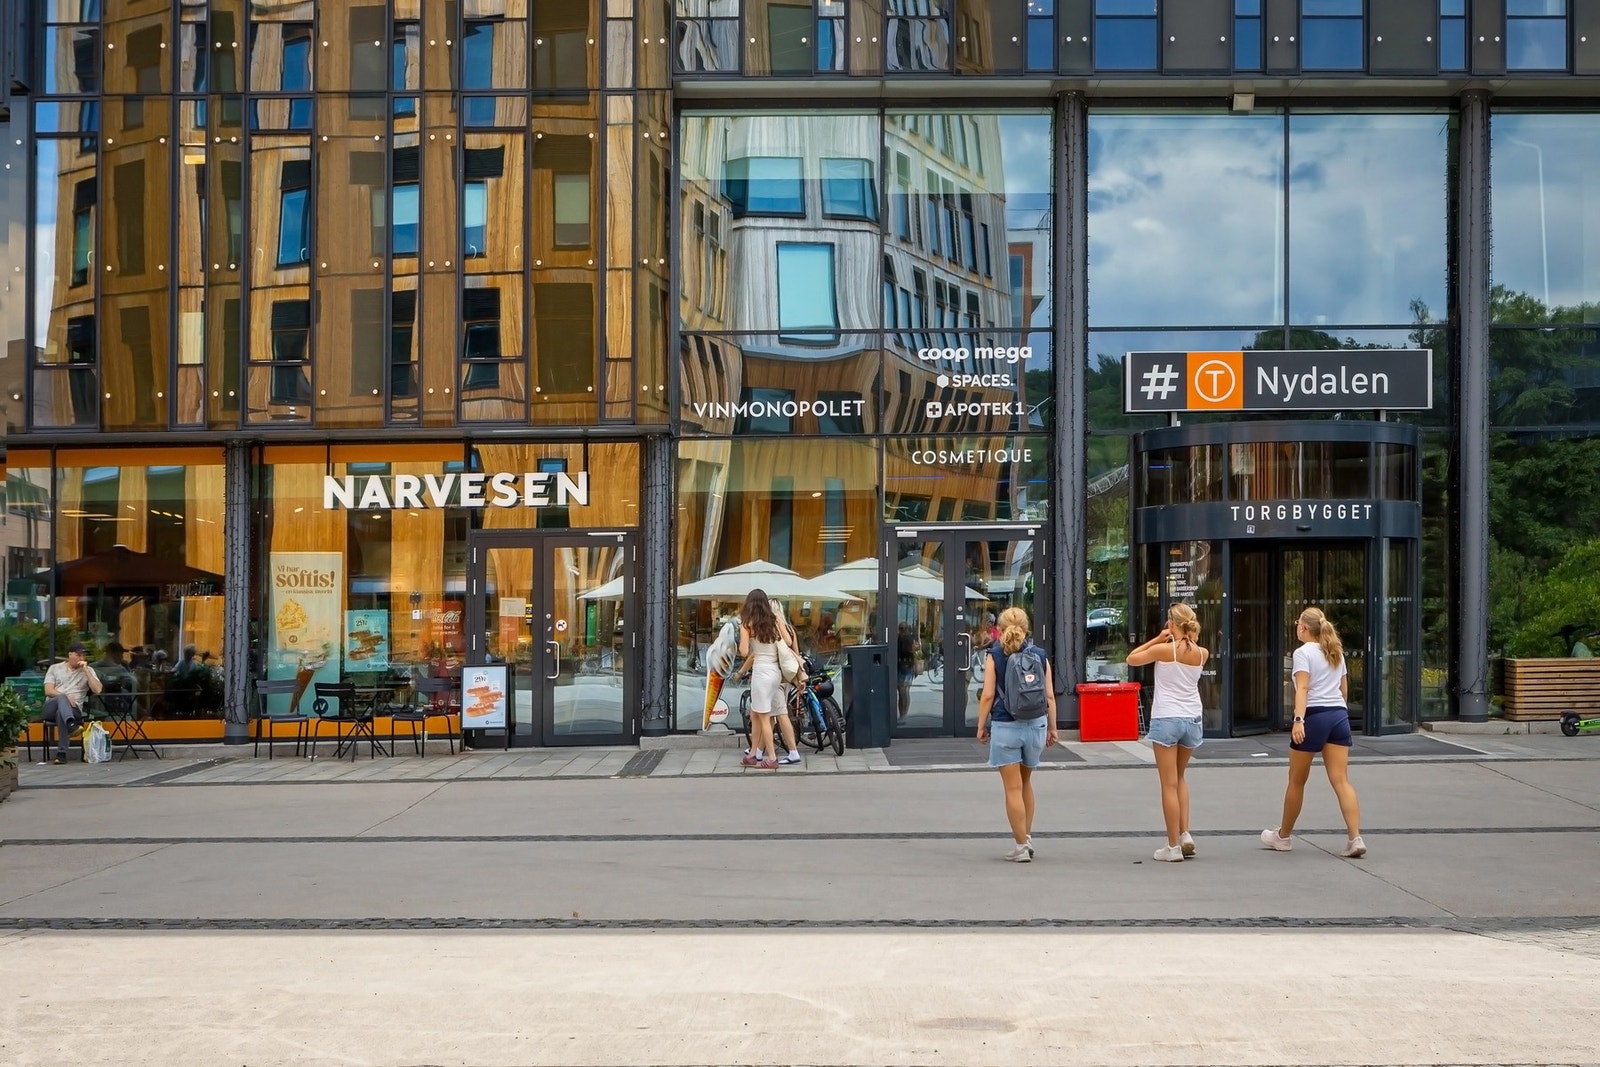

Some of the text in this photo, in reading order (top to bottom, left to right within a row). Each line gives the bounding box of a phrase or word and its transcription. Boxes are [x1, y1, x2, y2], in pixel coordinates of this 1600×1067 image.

[918, 346, 1032, 364] coop mega
[952, 374, 1014, 387] SPACES.
[1257, 366, 1389, 402] Nydalen
[694, 400, 866, 418] VINMONOPOLET
[945, 401, 1025, 416] APOTEK 1
[912, 449, 1032, 464] COSMETIQUE
[323, 471, 588, 509] NARVESEN
[1230, 504, 1372, 521] TORGBYGGET
[276, 569, 335, 588] softis!
